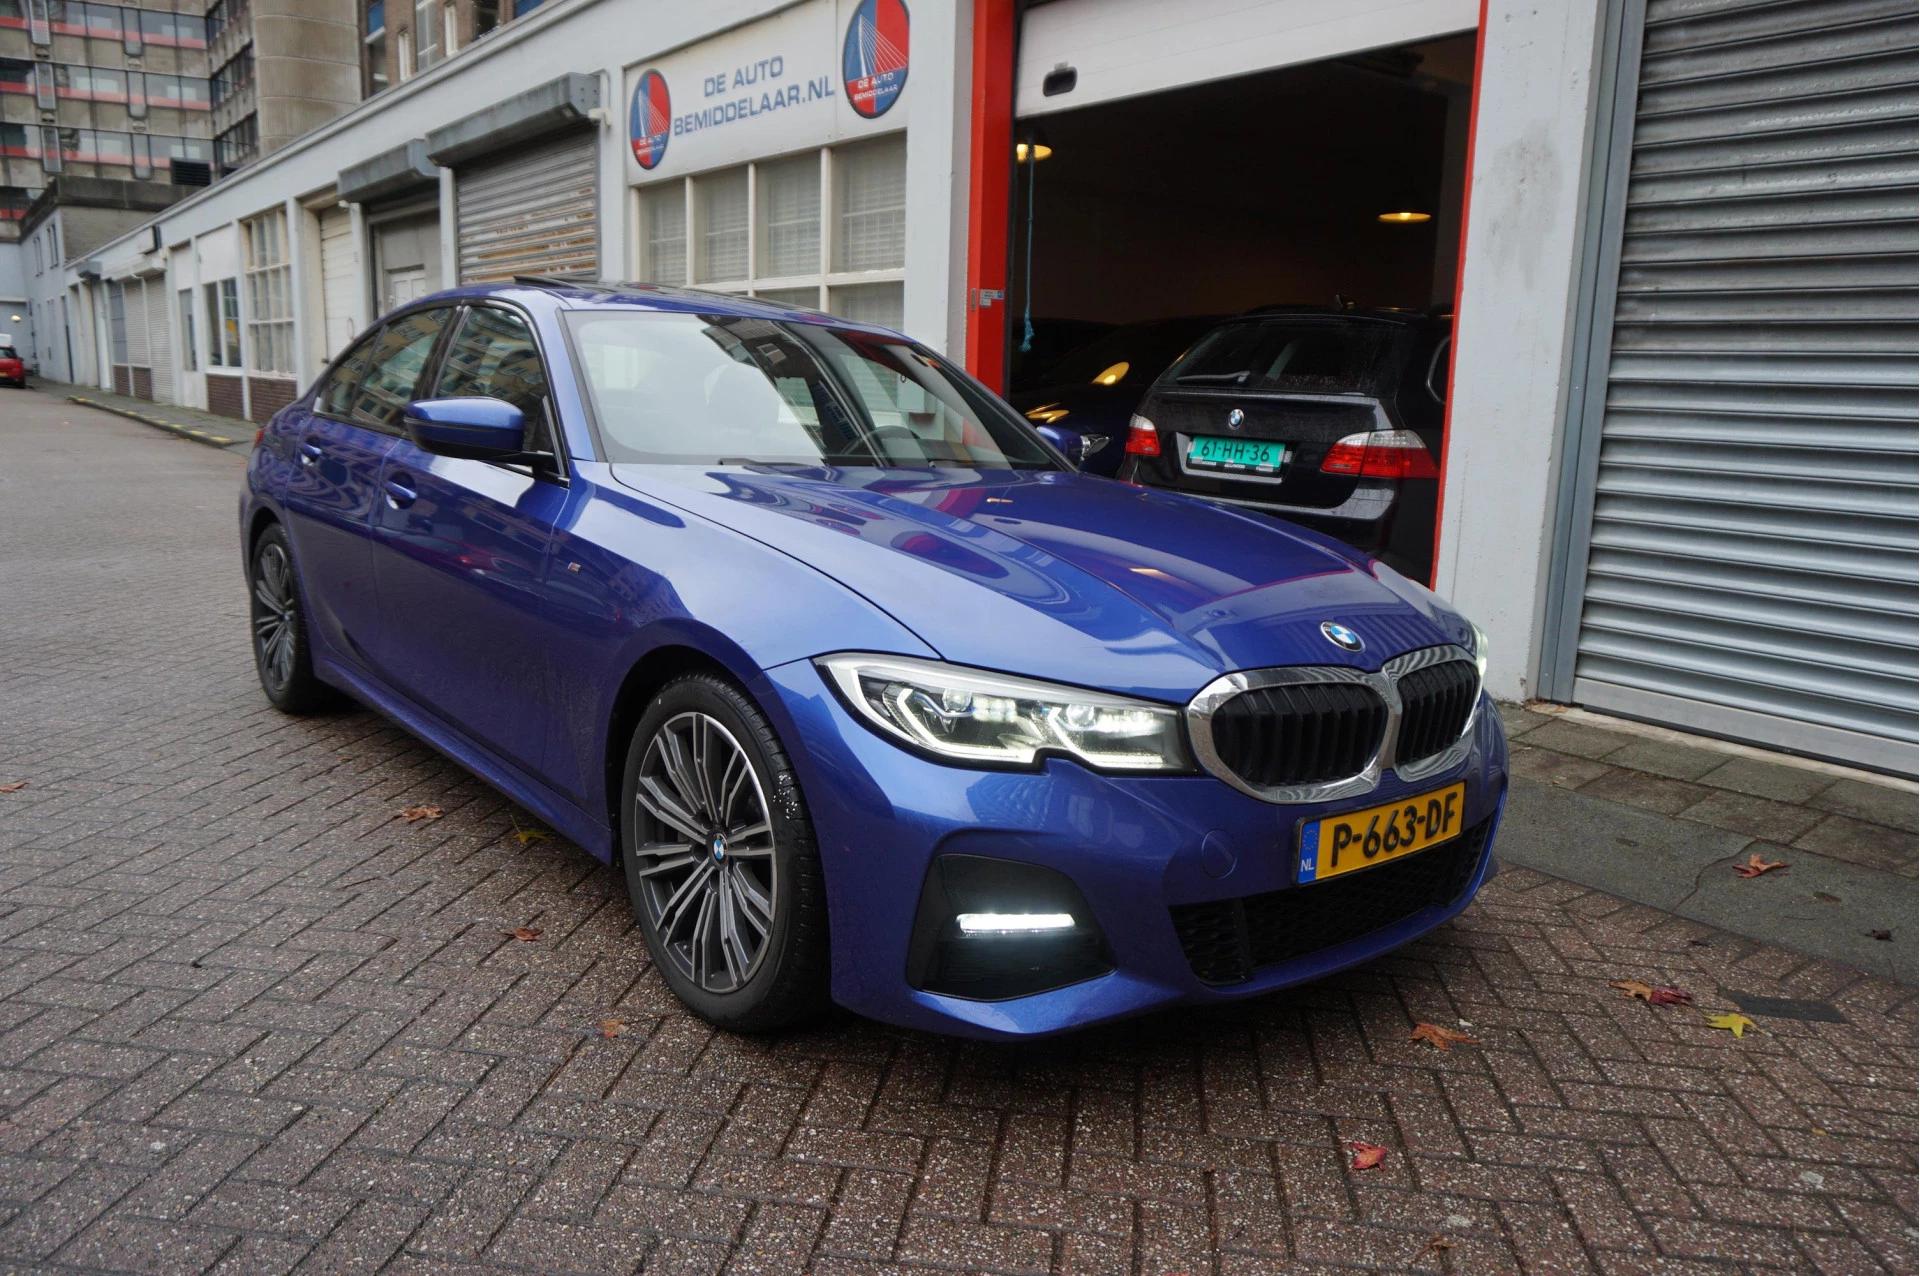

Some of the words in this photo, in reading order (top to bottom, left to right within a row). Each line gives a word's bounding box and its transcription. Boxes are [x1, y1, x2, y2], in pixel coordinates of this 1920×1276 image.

[704, 73, 726, 97] DE
[732, 55, 783, 89] AUTO
[858, 79, 869, 89] DE
[871, 72, 894, 86] AUTO
[673, 75, 835, 136] BEMIDDELAAR.NL
[1201, 440, 1270, 462] 61-HH-36
[1331, 791, 1458, 868] P-663-DF
[1300, 857, 1315, 873] NL
